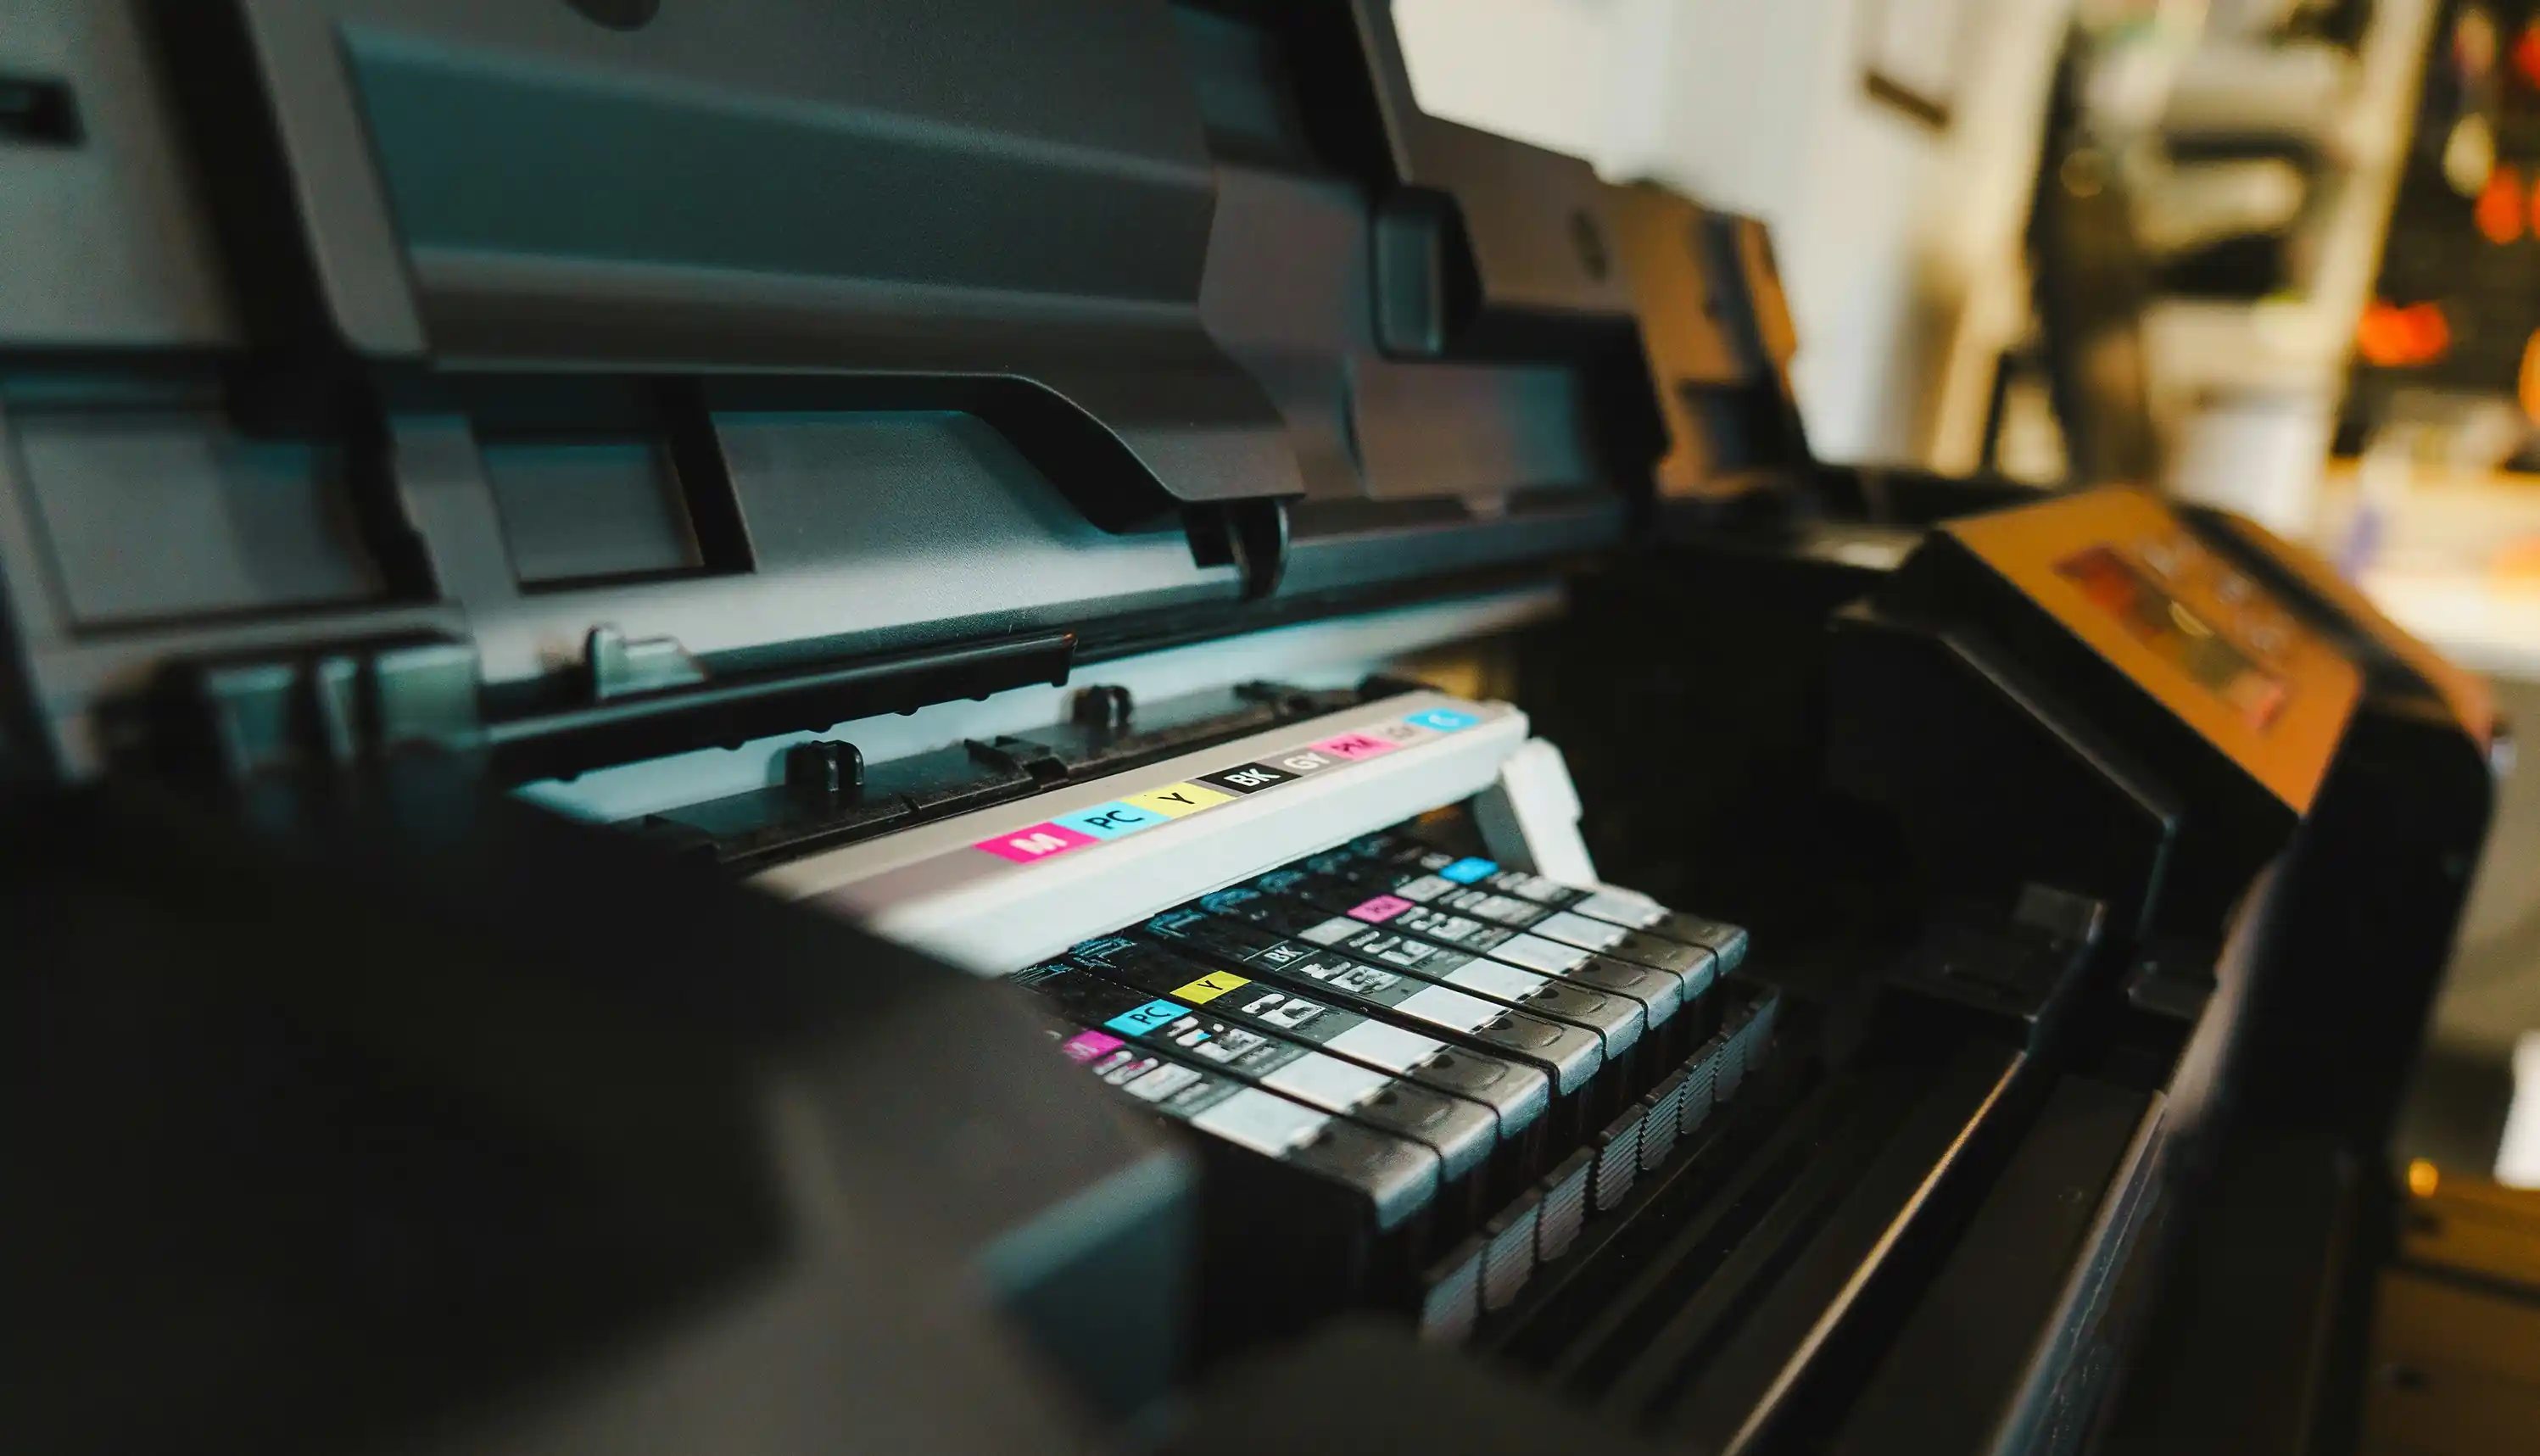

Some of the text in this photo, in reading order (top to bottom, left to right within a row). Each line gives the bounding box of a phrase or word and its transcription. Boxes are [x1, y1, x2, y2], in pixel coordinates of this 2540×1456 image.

[1010, 832, 1067, 855] M
[1084, 810, 1145, 830] PC
[1157, 792, 1195, 805] Y
[1222, 767, 1280, 789] BK
[1282, 751, 1331, 770] GY
[1264, 946, 1303, 963] BK
[1196, 979, 1224, 993] Y
[1129, 1007, 1171, 1025] PC
